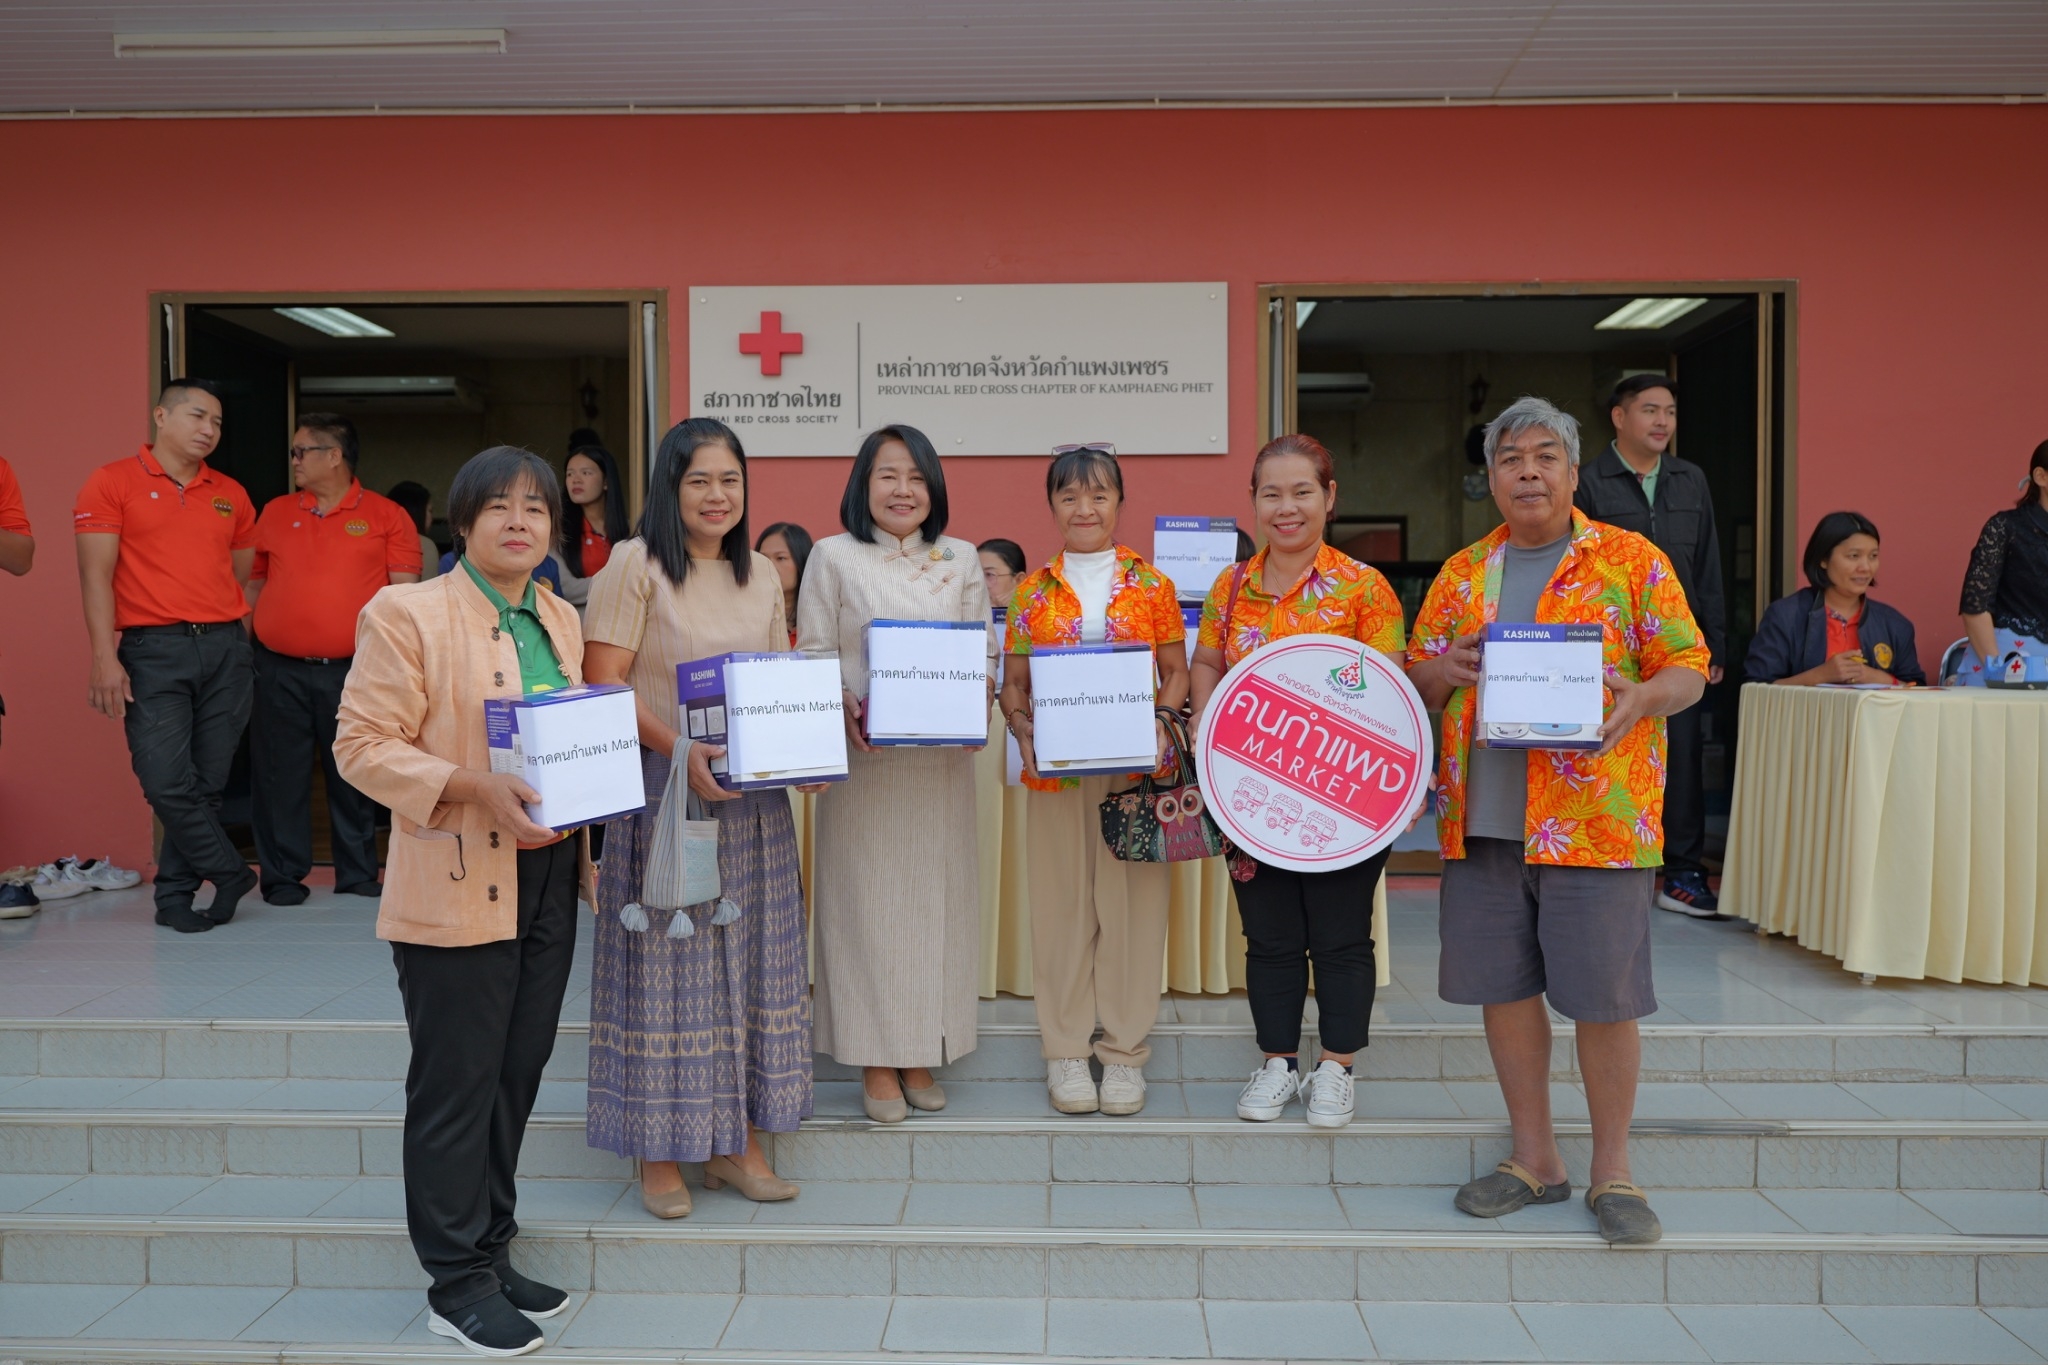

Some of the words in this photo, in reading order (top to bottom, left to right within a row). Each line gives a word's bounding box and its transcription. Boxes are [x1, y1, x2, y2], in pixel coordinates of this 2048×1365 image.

[877, 355, 1168, 377] เหล่ากาชาดจังหวัดกำแพงเพชร
[878, 385, 951, 395] PROVINCIAL
[954, 385, 977, 395] RED
[981, 384, 1018, 394] CROSS
[1021, 384, 1077, 394] CHAPTER
[1080, 384, 1097, 394] OF
[1099, 383, 1178, 394] KAMPHAENG
[1182, 383, 1214, 394] PHET
[703, 385, 842, 408] สภากาชาดไทย
[734, 415, 754, 424] RED
[757, 415, 790, 424] CROSS
[796, 415, 839, 424] SOCIETY
[1165, 521, 1200, 529] KASHIWA
[1503, 630, 1551, 639] KASHIWA
[690, 669, 716, 682] KASHIWA
[1488, 672, 1550, 683] ตลาดคนกำแพง
[1563, 674, 1596, 684] Market
[1277, 672, 1321, 699] อำเภอเมือง
[1323, 695, 1398, 737] จังหวัดกำแพงเพชร
[1228, 691, 1406, 793] คนกำแพง
[1241, 733, 1361, 803] MARKET
